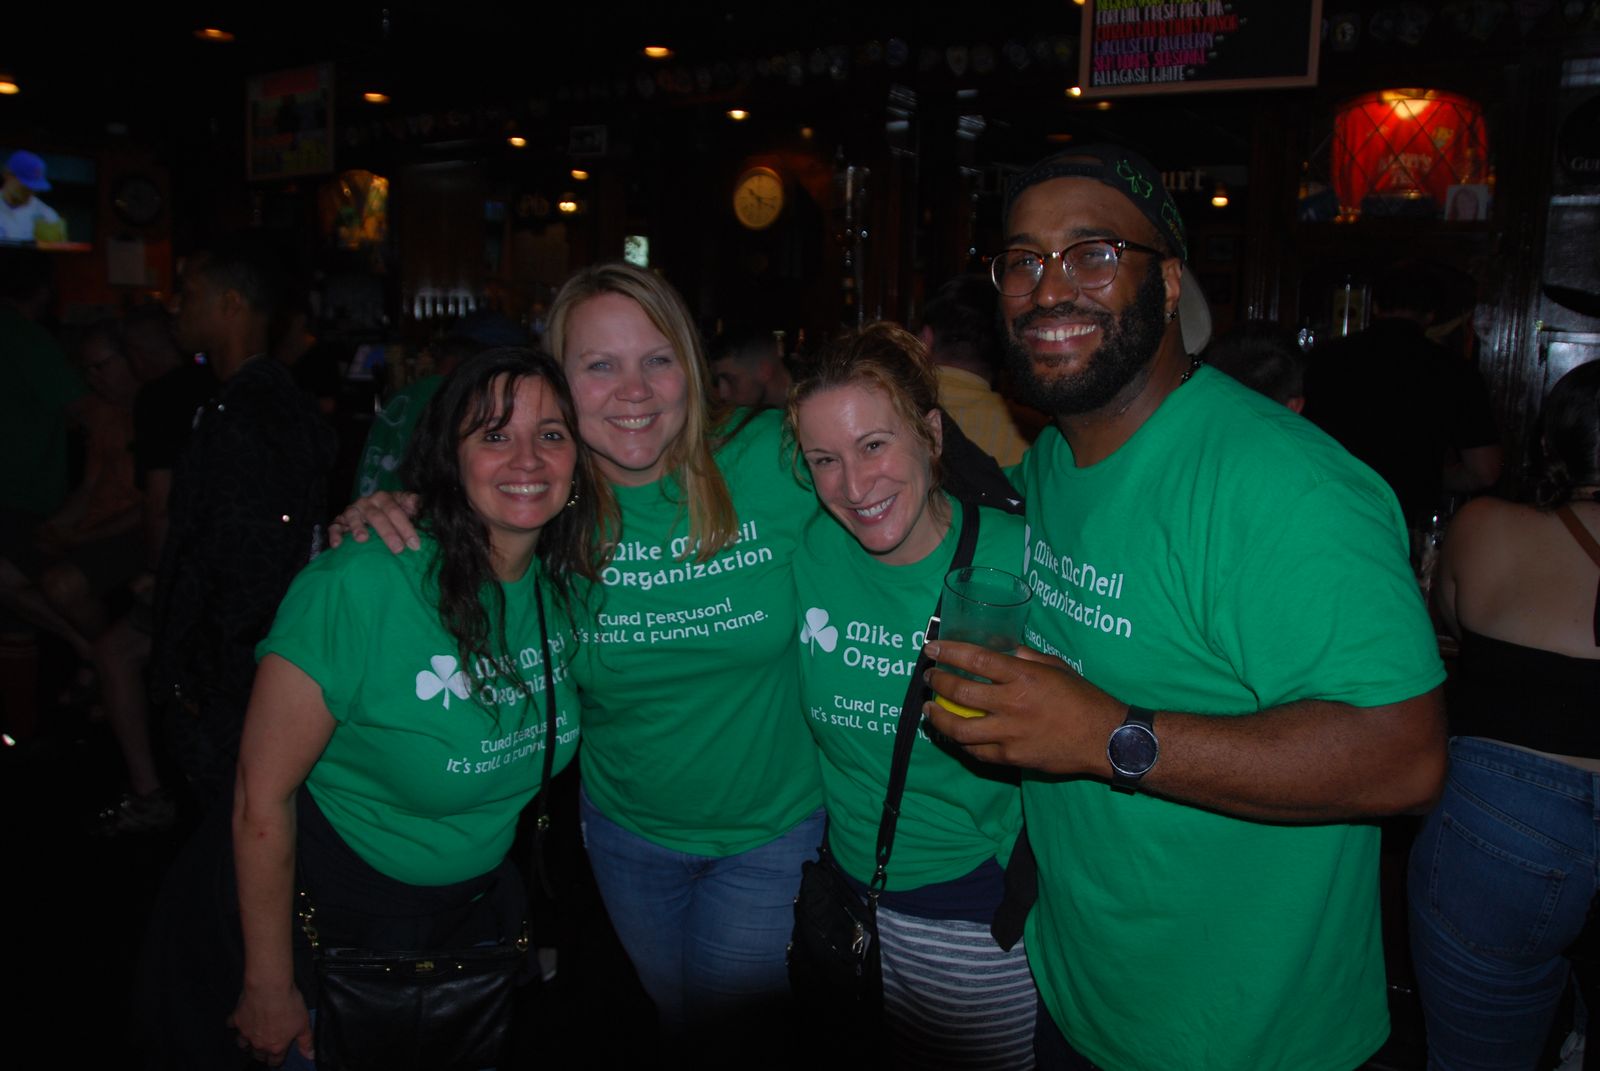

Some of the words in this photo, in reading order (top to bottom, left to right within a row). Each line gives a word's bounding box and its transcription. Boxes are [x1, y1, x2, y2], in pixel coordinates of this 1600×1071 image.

[1093, 67, 1149, 86] ALLAGASH
[1151, 65, 1185, 82] WHITE
[602, 546, 773, 590] Organization
[1034, 539, 1059, 574] Mike
[1062, 555, 1124, 600] McNeil
[714, 608, 769, 633] name.
[1028, 569, 1133, 639] Organization
[845, 620, 904, 649] Mike
